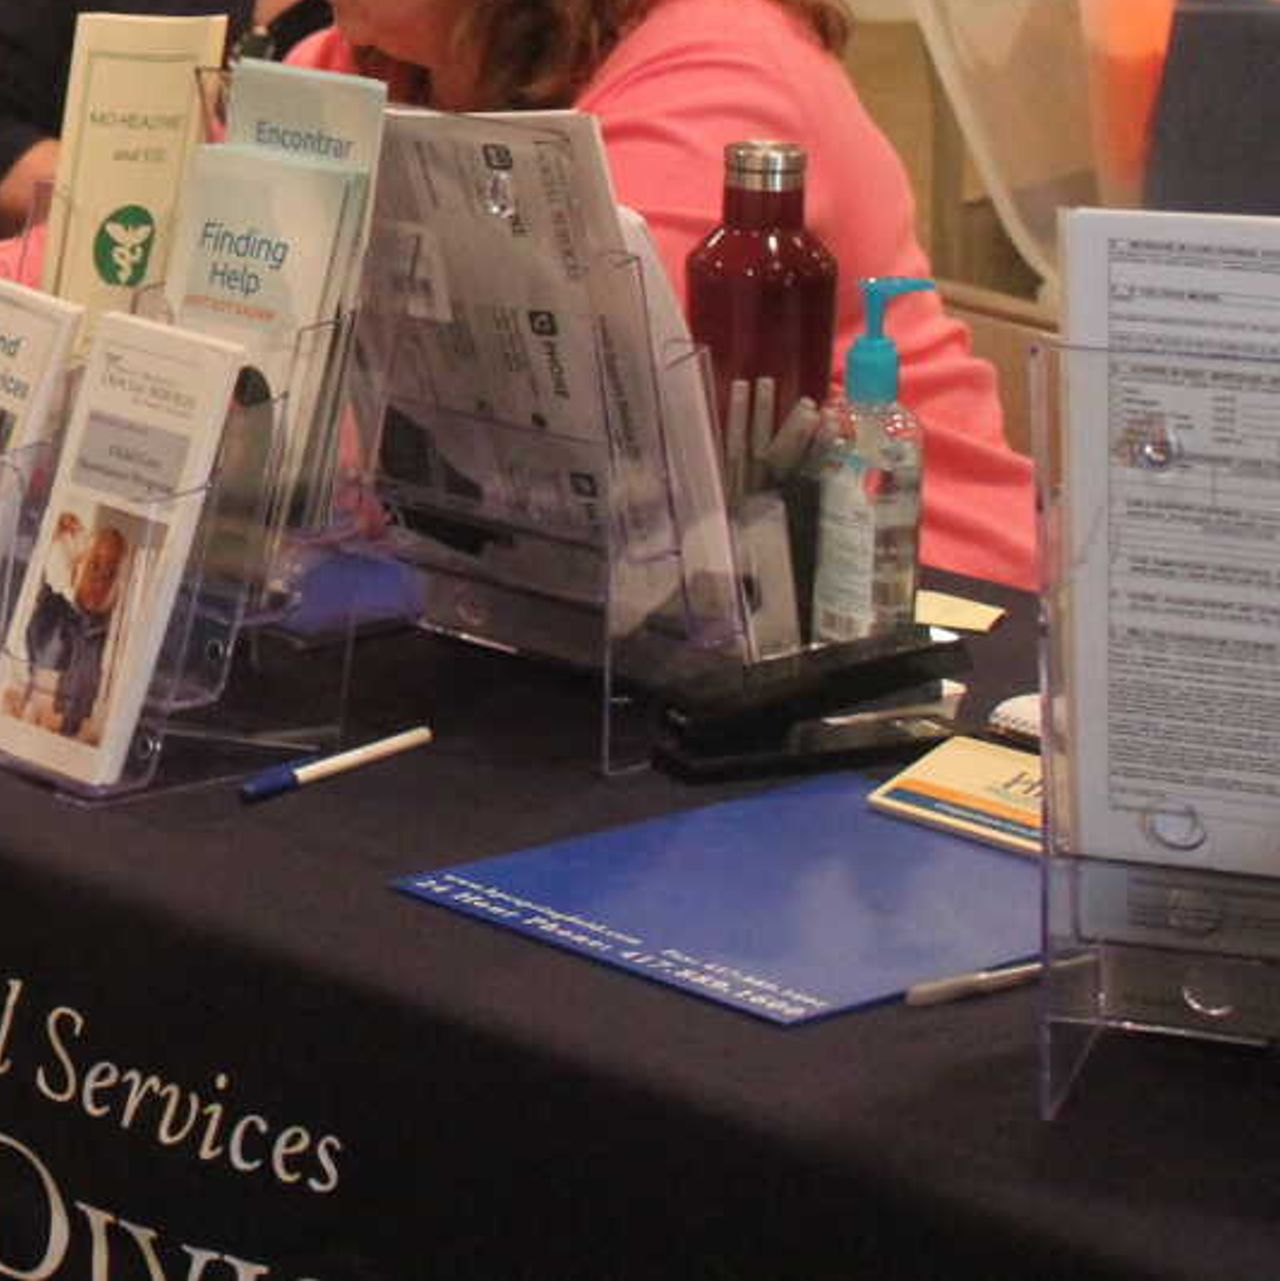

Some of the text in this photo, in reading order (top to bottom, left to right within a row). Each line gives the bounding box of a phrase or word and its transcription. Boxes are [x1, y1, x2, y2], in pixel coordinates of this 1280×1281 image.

[254, 120, 357, 161] Encontrar
[197, 220, 290, 271] Finding
[208, 262, 263, 297] Help
[35, 1006, 343, 1194] Services
